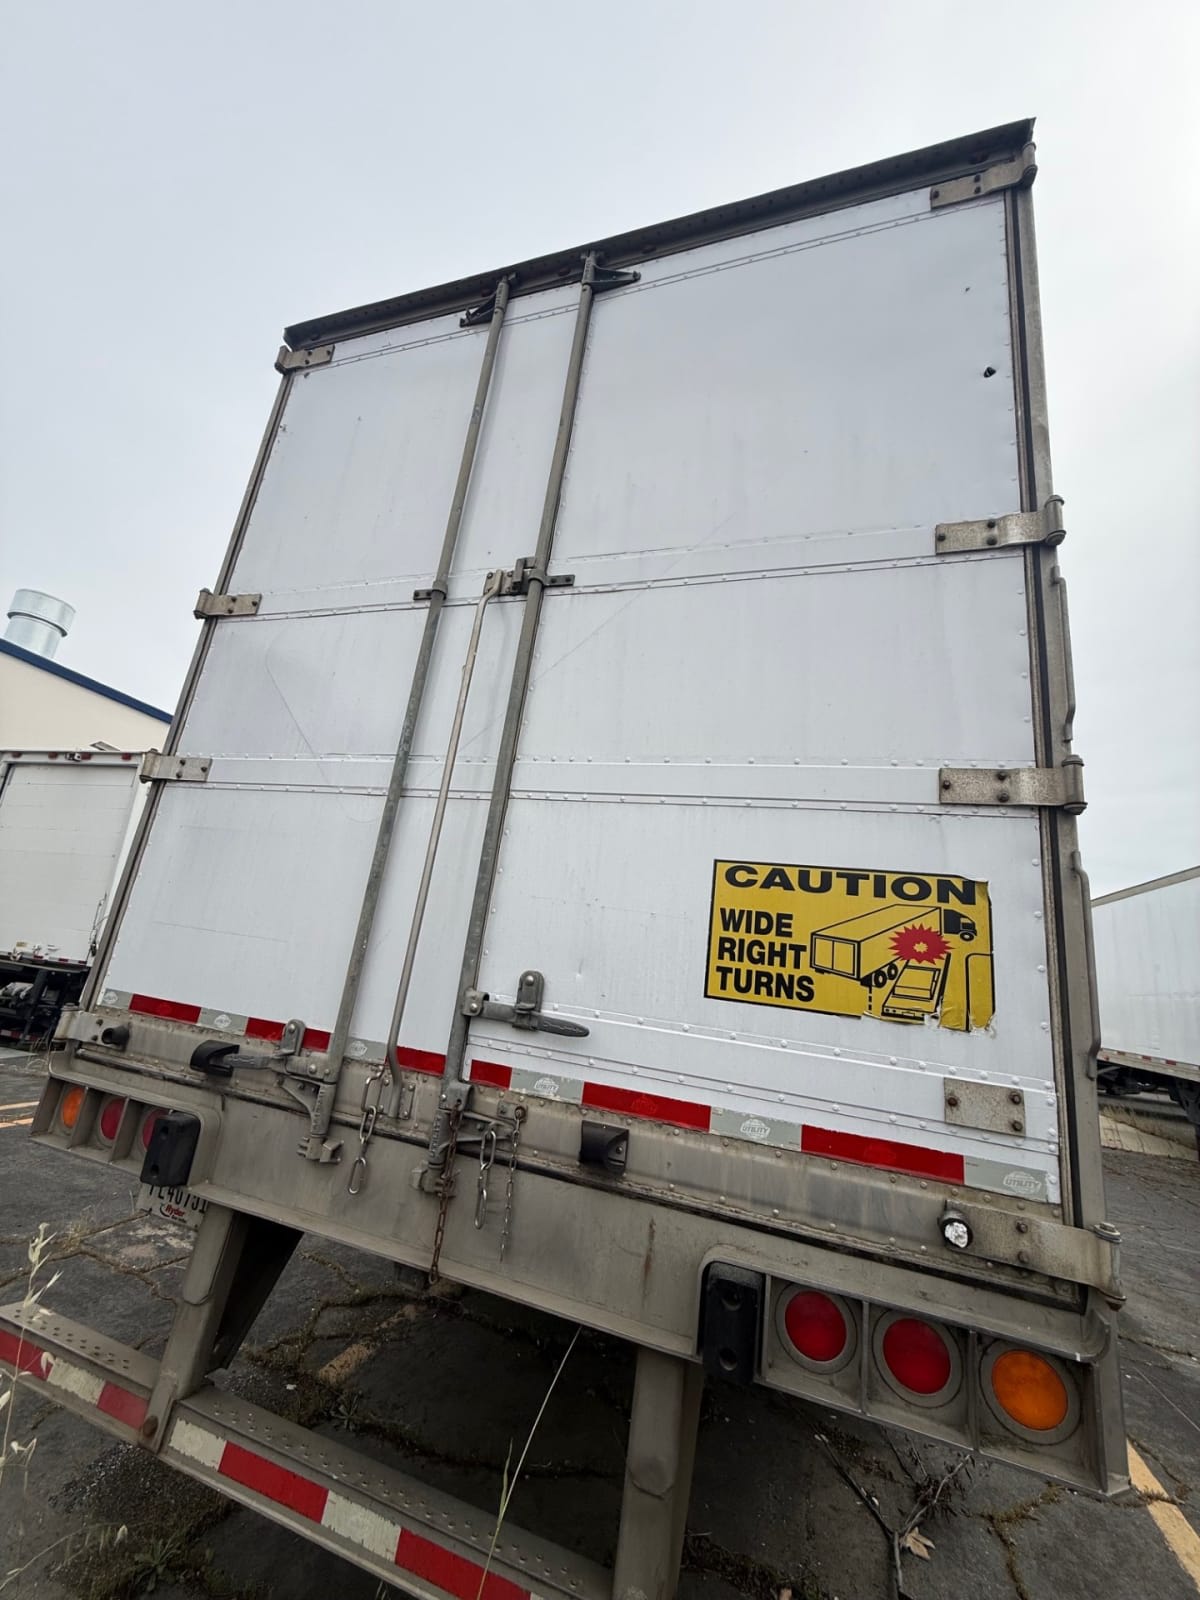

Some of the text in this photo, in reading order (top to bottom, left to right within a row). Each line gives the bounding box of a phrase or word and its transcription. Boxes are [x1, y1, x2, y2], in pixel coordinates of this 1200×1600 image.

[724, 864, 976, 905] CAUTION
[719, 907, 793, 938] WIDE
[717, 937, 807, 969] RIGHT
[715, 966, 815, 1002] TURNS
[164, 1204, 185, 1217] Ryder
